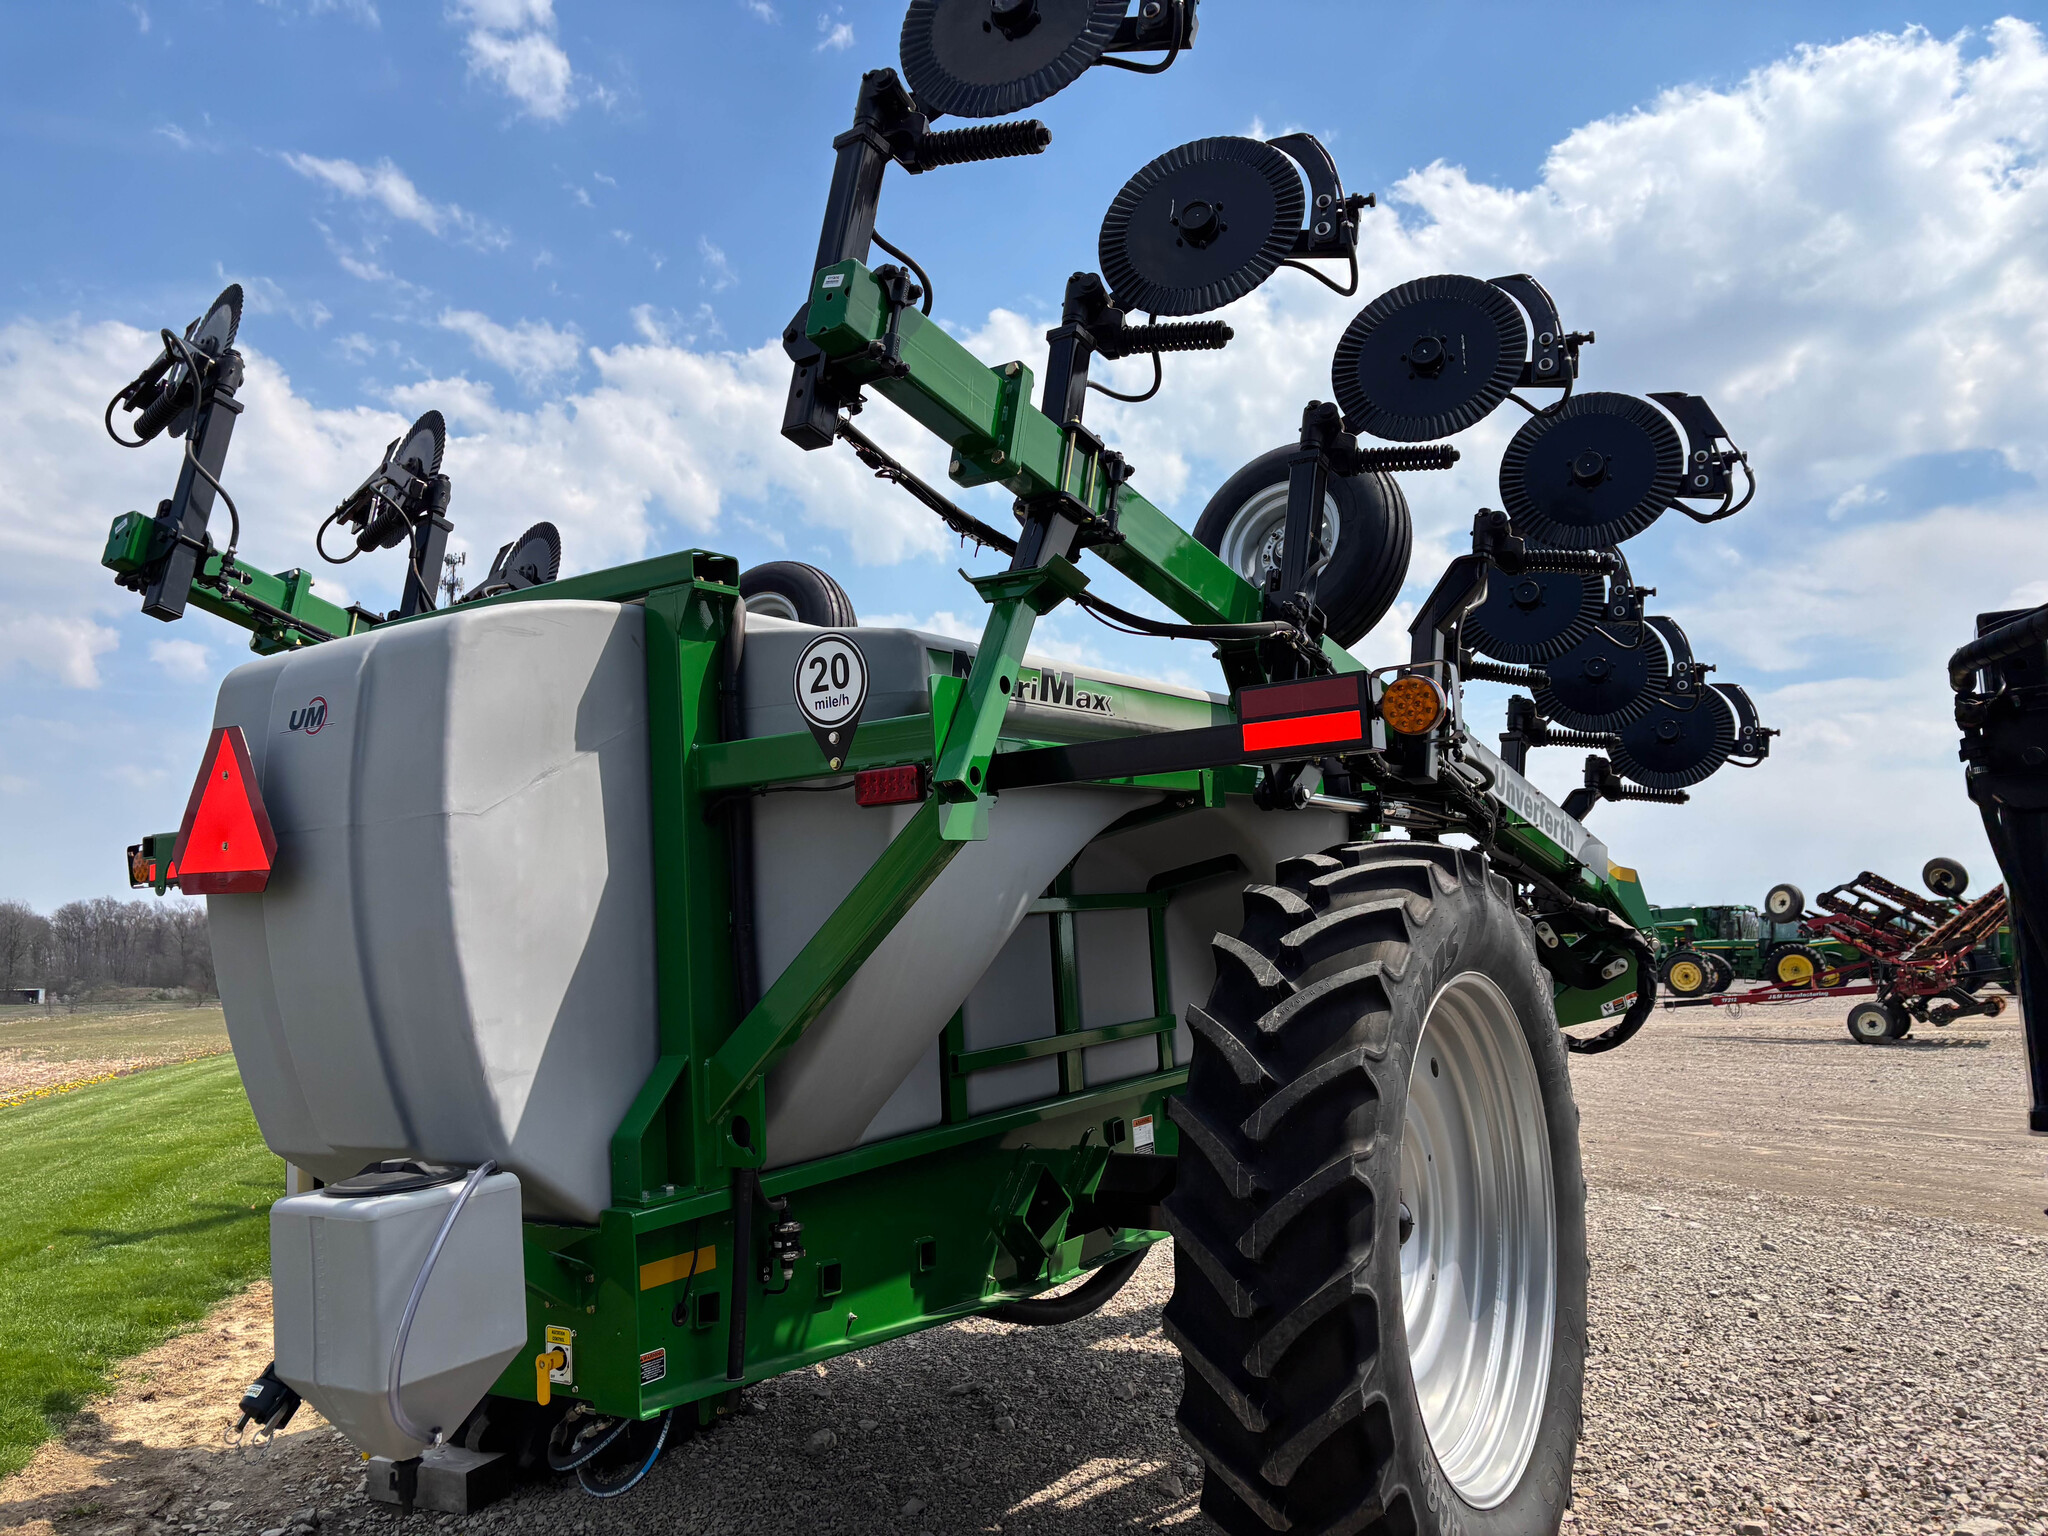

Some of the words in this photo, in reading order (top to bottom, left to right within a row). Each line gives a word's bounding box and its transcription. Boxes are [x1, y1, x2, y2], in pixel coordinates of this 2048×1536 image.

[808, 652, 850, 694] 20
[814, 693, 850, 710] mile/h
[288, 704, 326, 731] UM
[1494, 763, 1575, 852] Unverferth
[1783, 990, 1829, 999] Manufacturing
